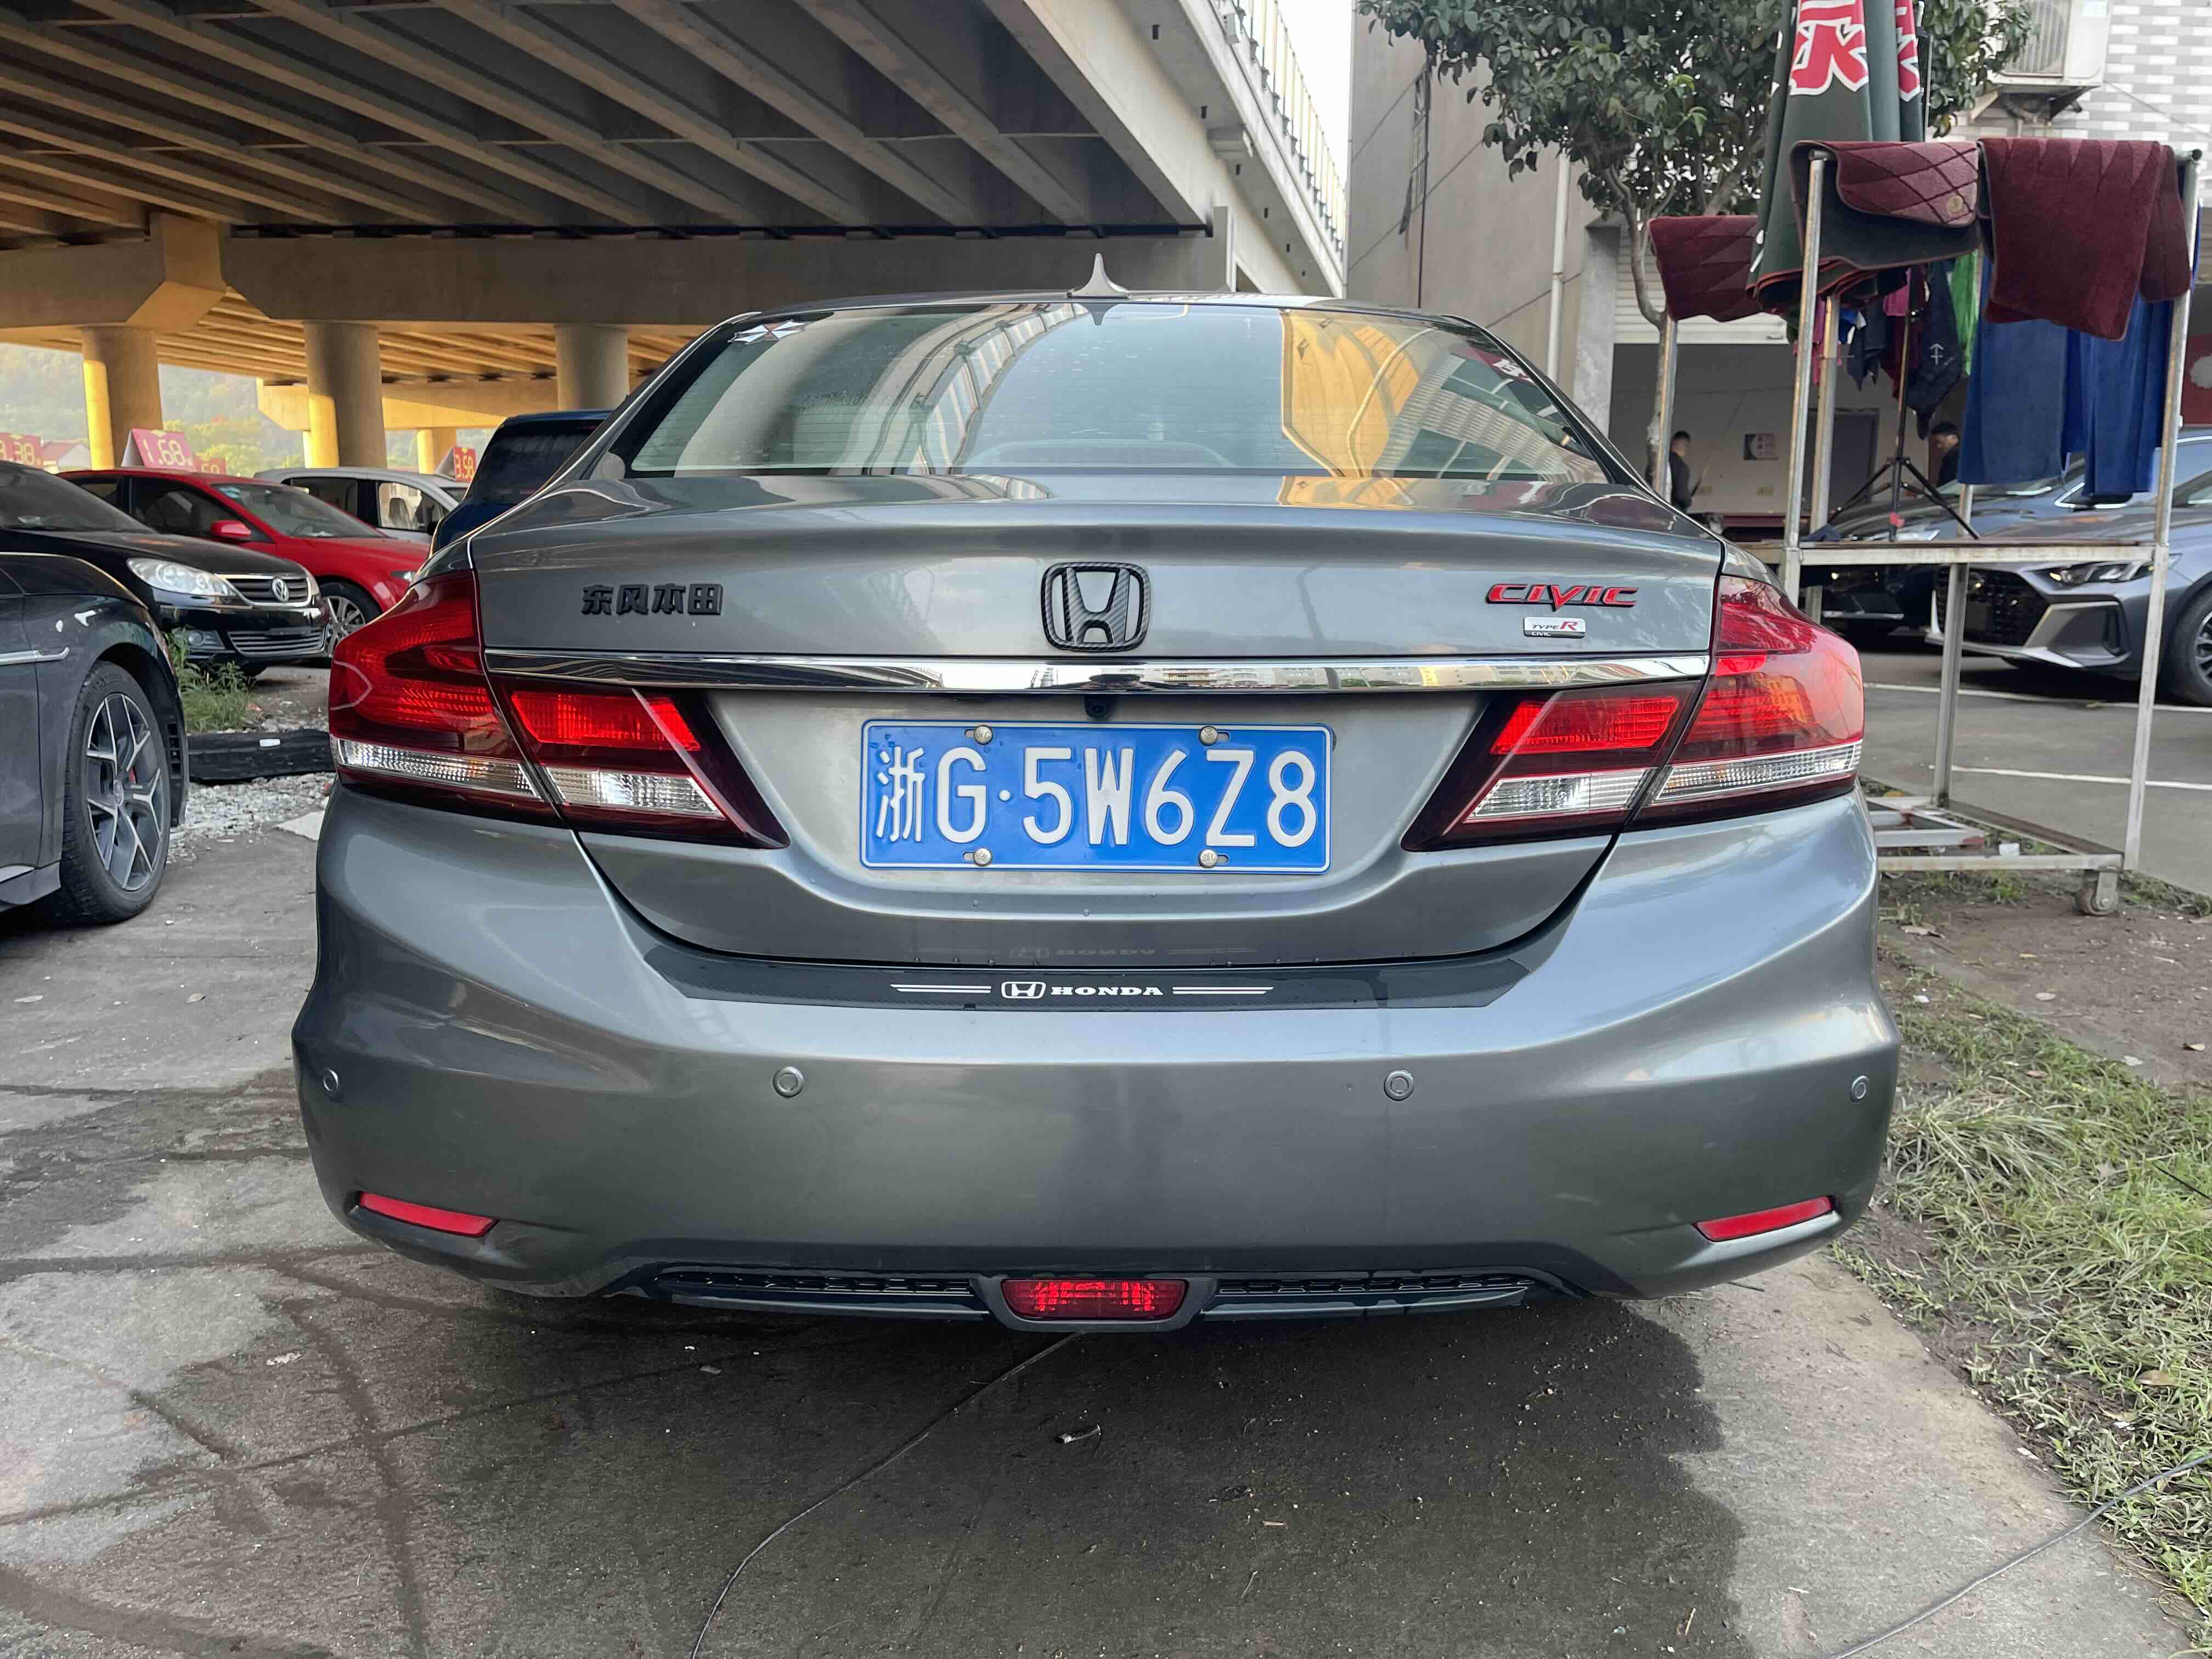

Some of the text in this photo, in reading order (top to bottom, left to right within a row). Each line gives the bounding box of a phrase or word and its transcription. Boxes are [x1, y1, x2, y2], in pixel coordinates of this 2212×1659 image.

[581, 583, 723, 615] 东风本田
[1486, 584, 1638, 612] CIVIC
[876, 746, 1317, 848] 浙G·5W6Z8
[1051, 987, 1163, 995] HONDA
